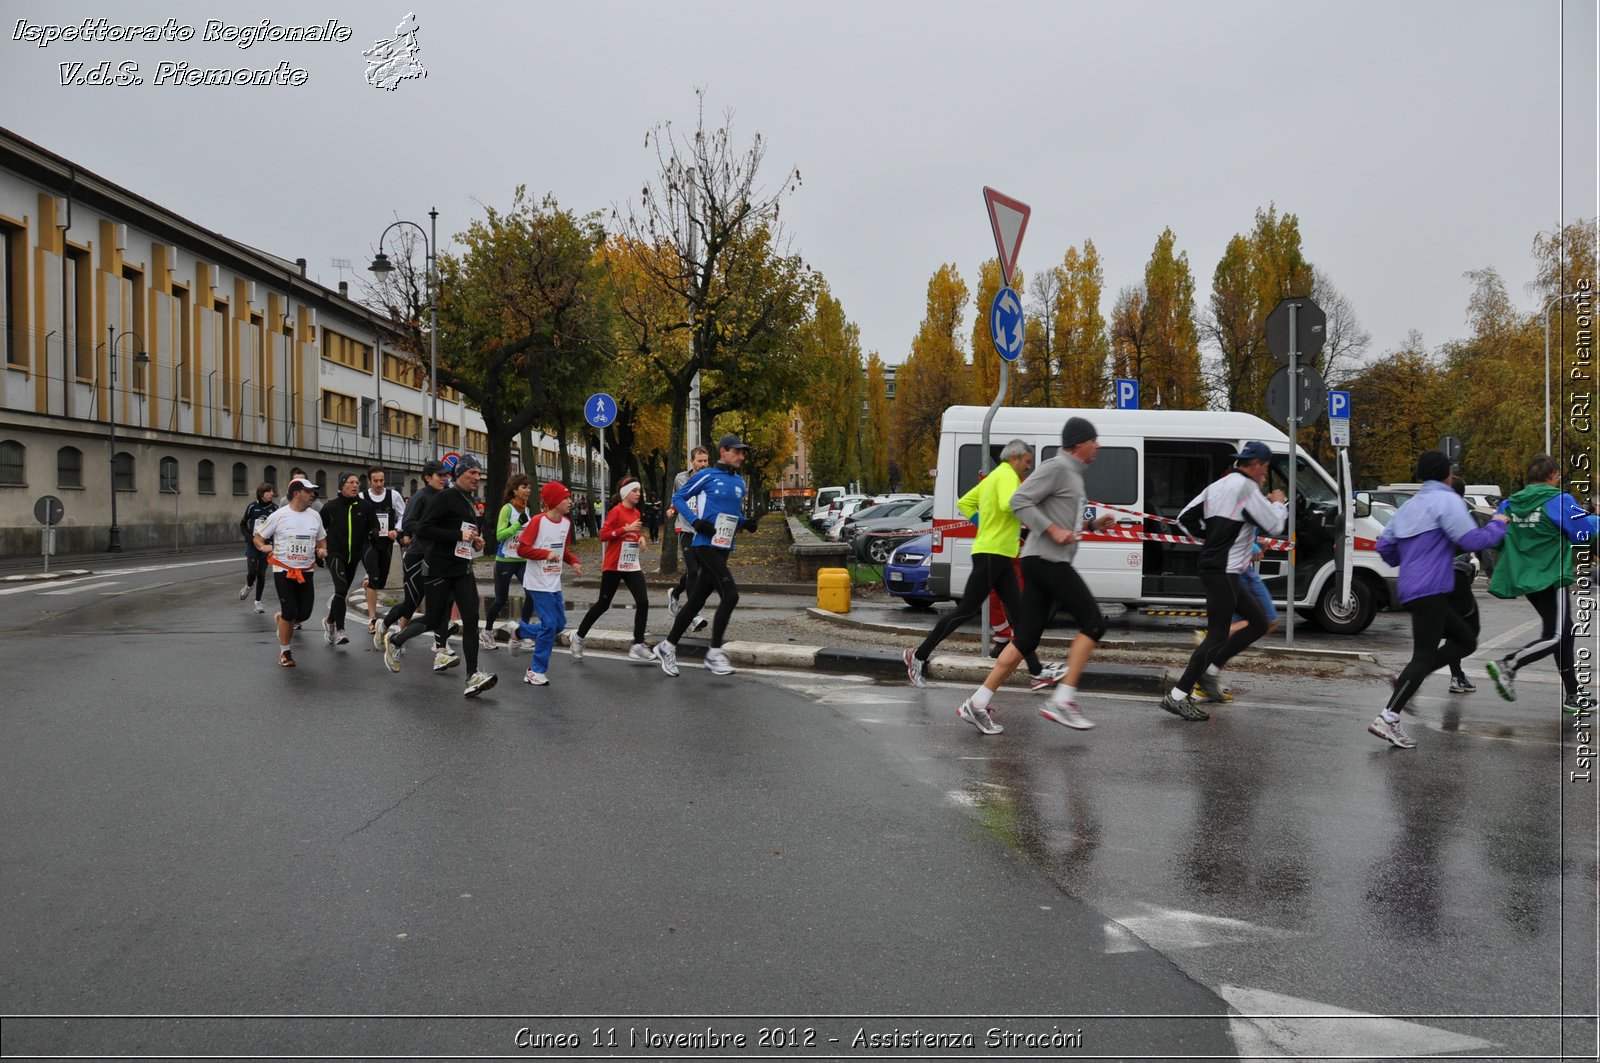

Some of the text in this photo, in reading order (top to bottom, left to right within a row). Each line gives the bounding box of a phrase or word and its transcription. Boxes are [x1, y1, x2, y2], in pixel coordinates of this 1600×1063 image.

[1120, 382, 1134, 408] P
[1332, 393, 1346, 416] P
[290, 544, 308, 553] 3914
